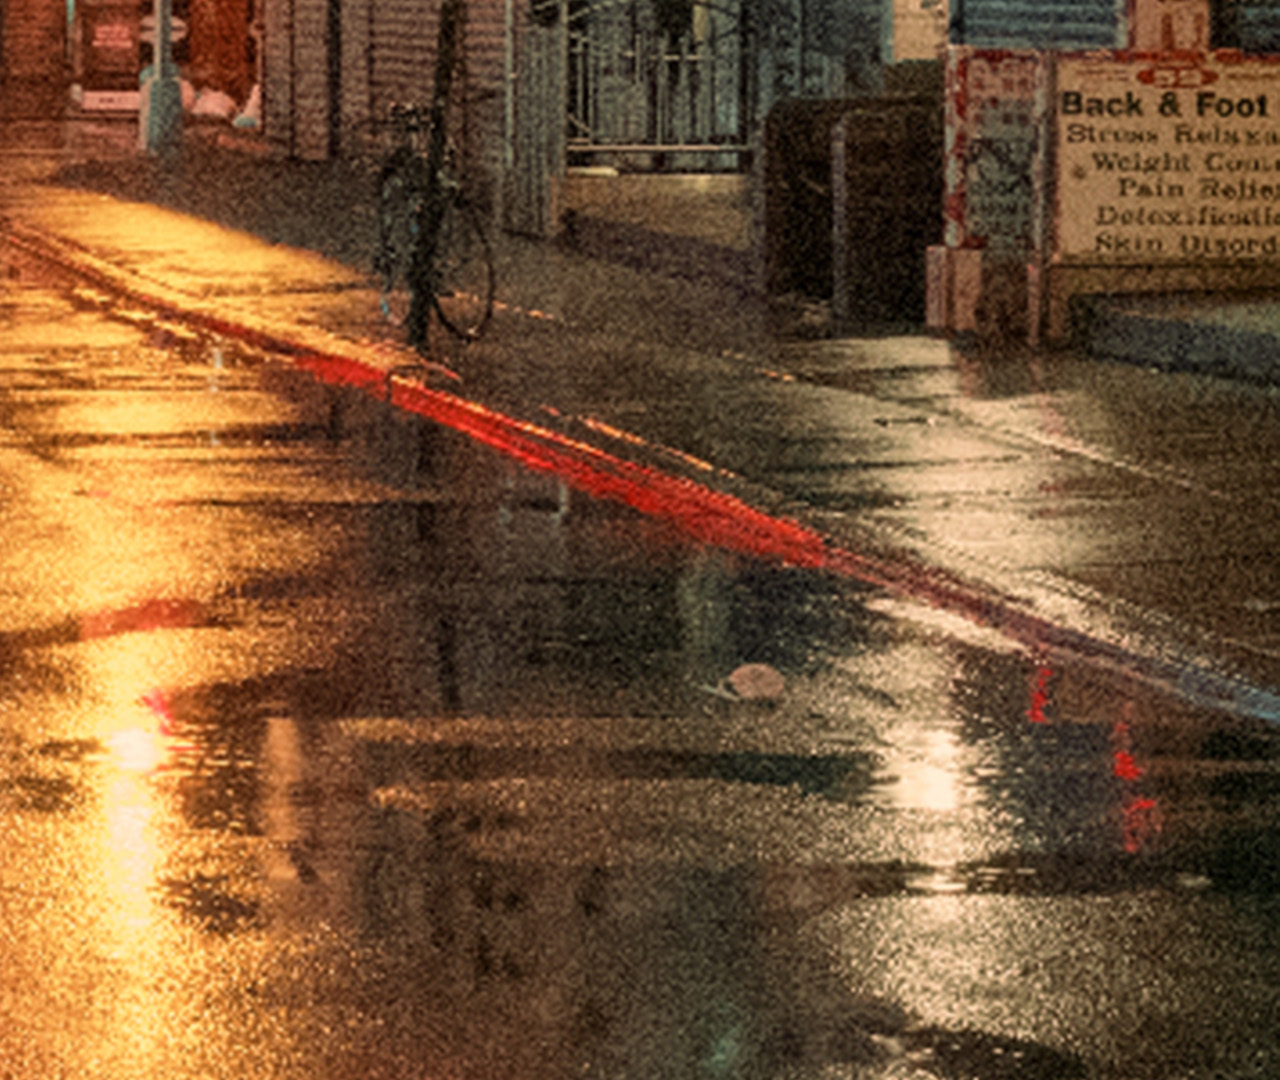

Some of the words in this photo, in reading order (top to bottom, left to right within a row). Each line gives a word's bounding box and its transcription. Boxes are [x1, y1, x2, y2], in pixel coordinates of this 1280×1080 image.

[1060, 90, 1144, 117] Back
[1158, 92, 1182, 117] &
[1196, 91, 1270, 118] Foot
[1091, 151, 1192, 175] Weight
[1117, 176, 1185, 198] Pain
[1095, 229, 1164, 253] Skin
